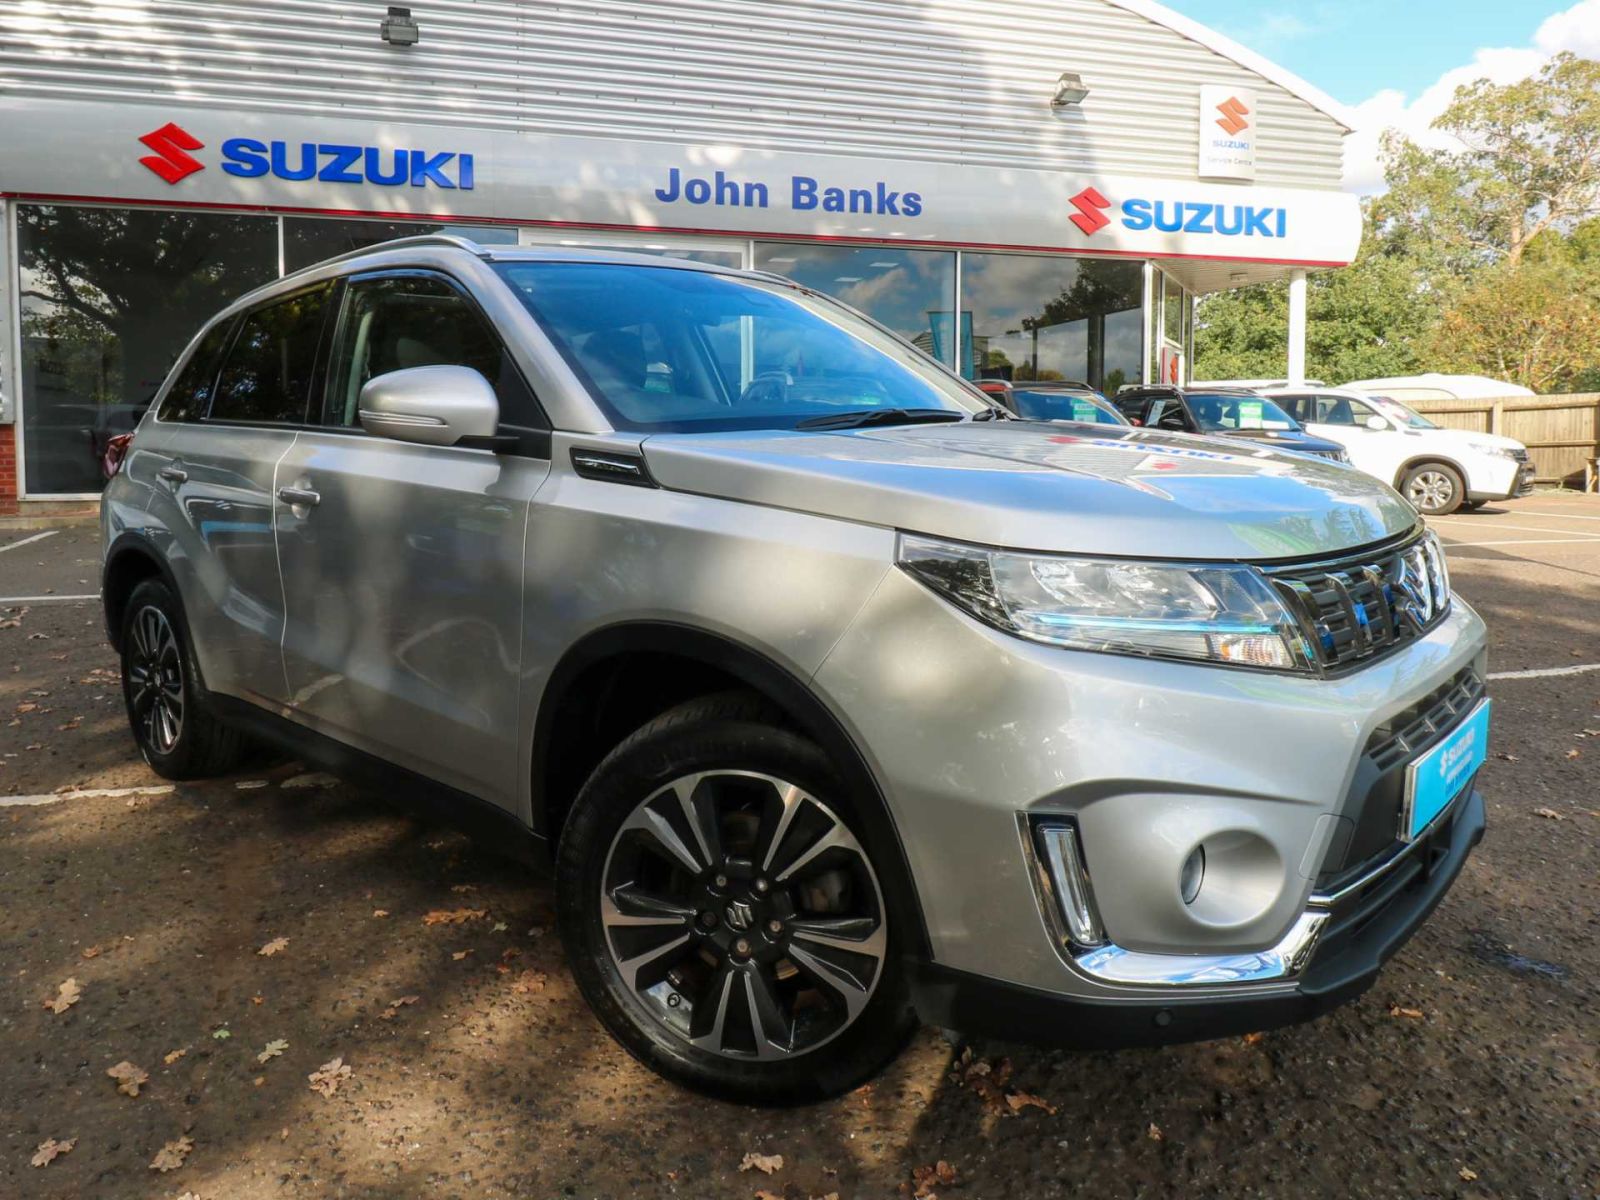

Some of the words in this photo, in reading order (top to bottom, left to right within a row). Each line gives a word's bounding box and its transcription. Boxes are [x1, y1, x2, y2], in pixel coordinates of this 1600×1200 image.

[221, 138, 474, 190] SUZUKI
[1212, 140, 1250, 150] SUZUKI
[655, 168, 768, 208] John
[792, 176, 922, 217] Banks
[1121, 198, 1286, 238] SUZUKI
